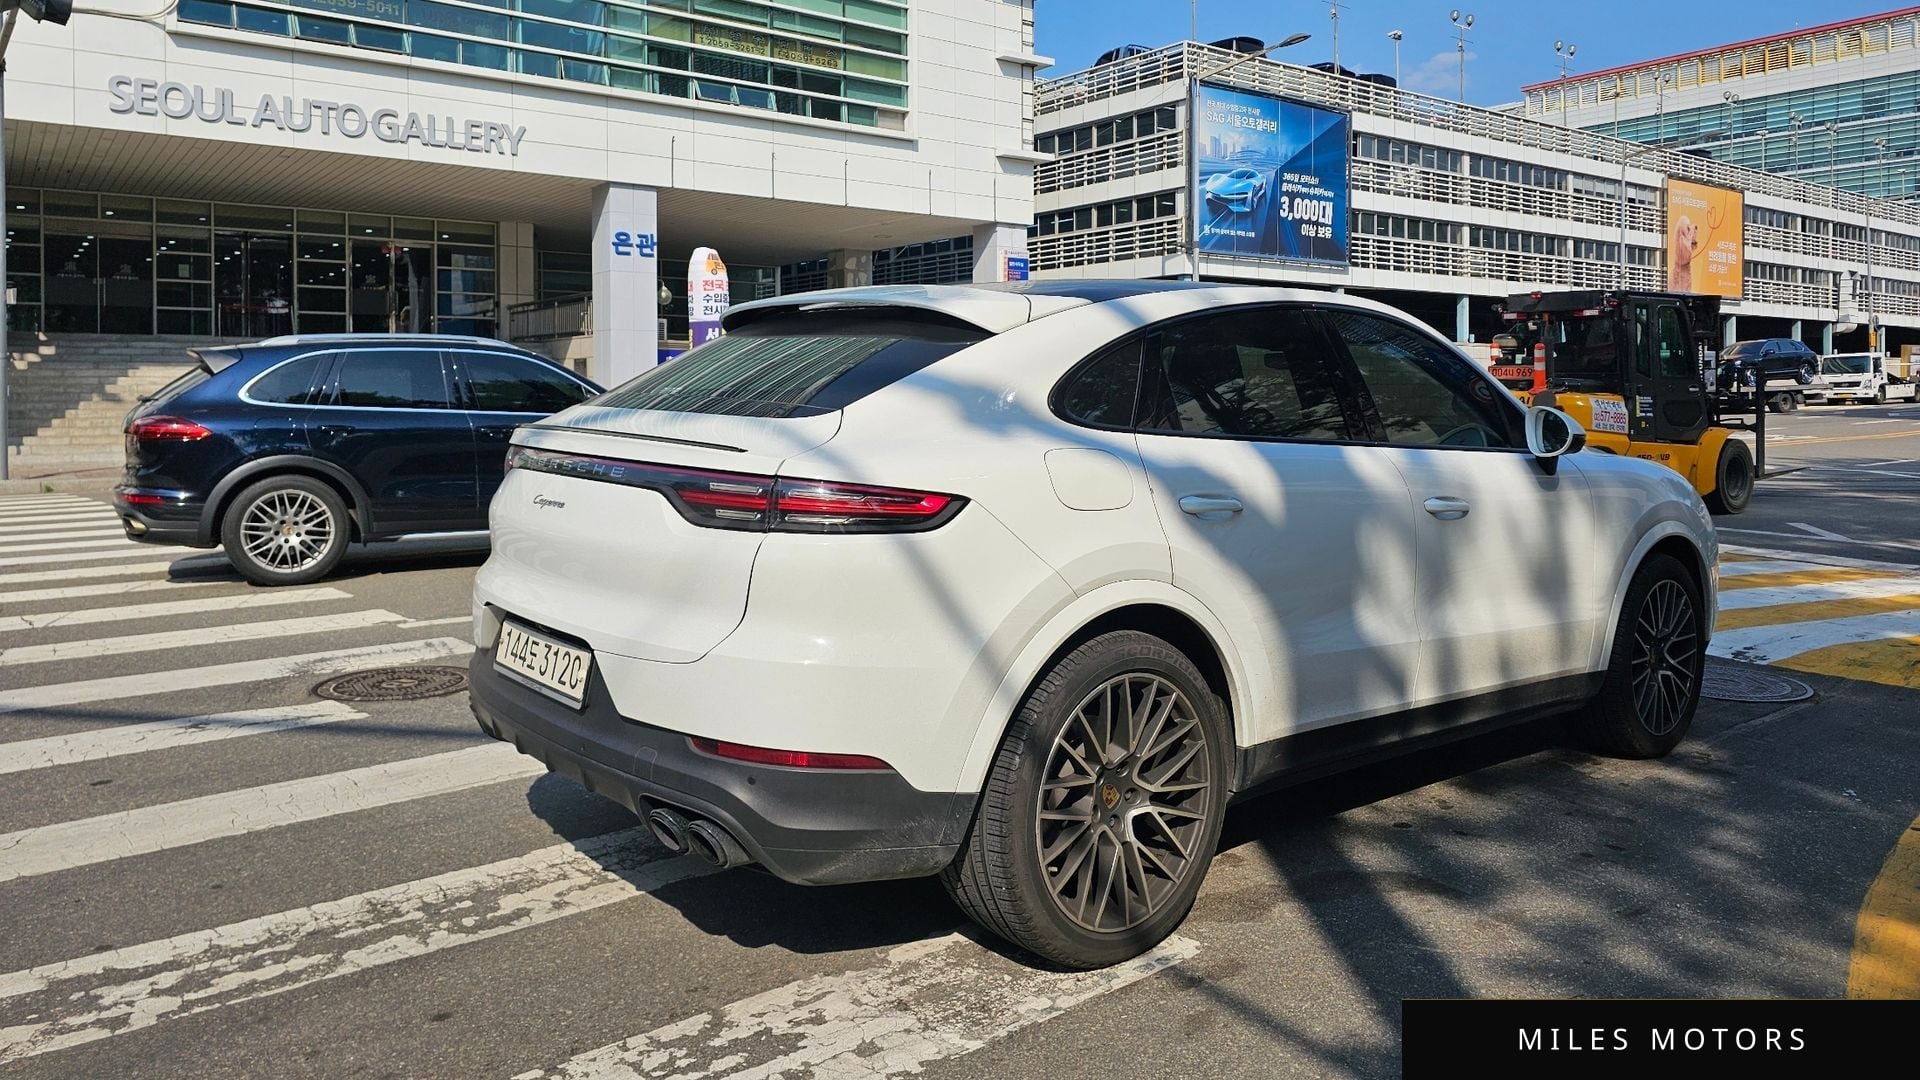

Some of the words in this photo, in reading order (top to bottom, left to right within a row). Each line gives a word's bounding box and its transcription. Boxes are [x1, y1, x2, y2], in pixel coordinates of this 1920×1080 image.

[108, 75, 245, 125] SEOUL
[251, 94, 367, 137] AUTO
[371, 108, 526, 157] GALLERY
[1206, 111, 1225, 123] SAG
[1226, 114, 1277, 134] 서울오토갤러리
[1282, 173, 1299, 182] 365일
[1280, 196, 1333, 225] 3,000대
[1301, 224, 1317, 237] 이상
[1317, 226, 1333, 238] 보유
[612, 231, 657, 258] 은관
[703, 280, 724, 291] 전국
[528, 457, 625, 477] PORSCHE
[504, 628, 539, 670] 144도
[539, 643, 581, 689] 3120
